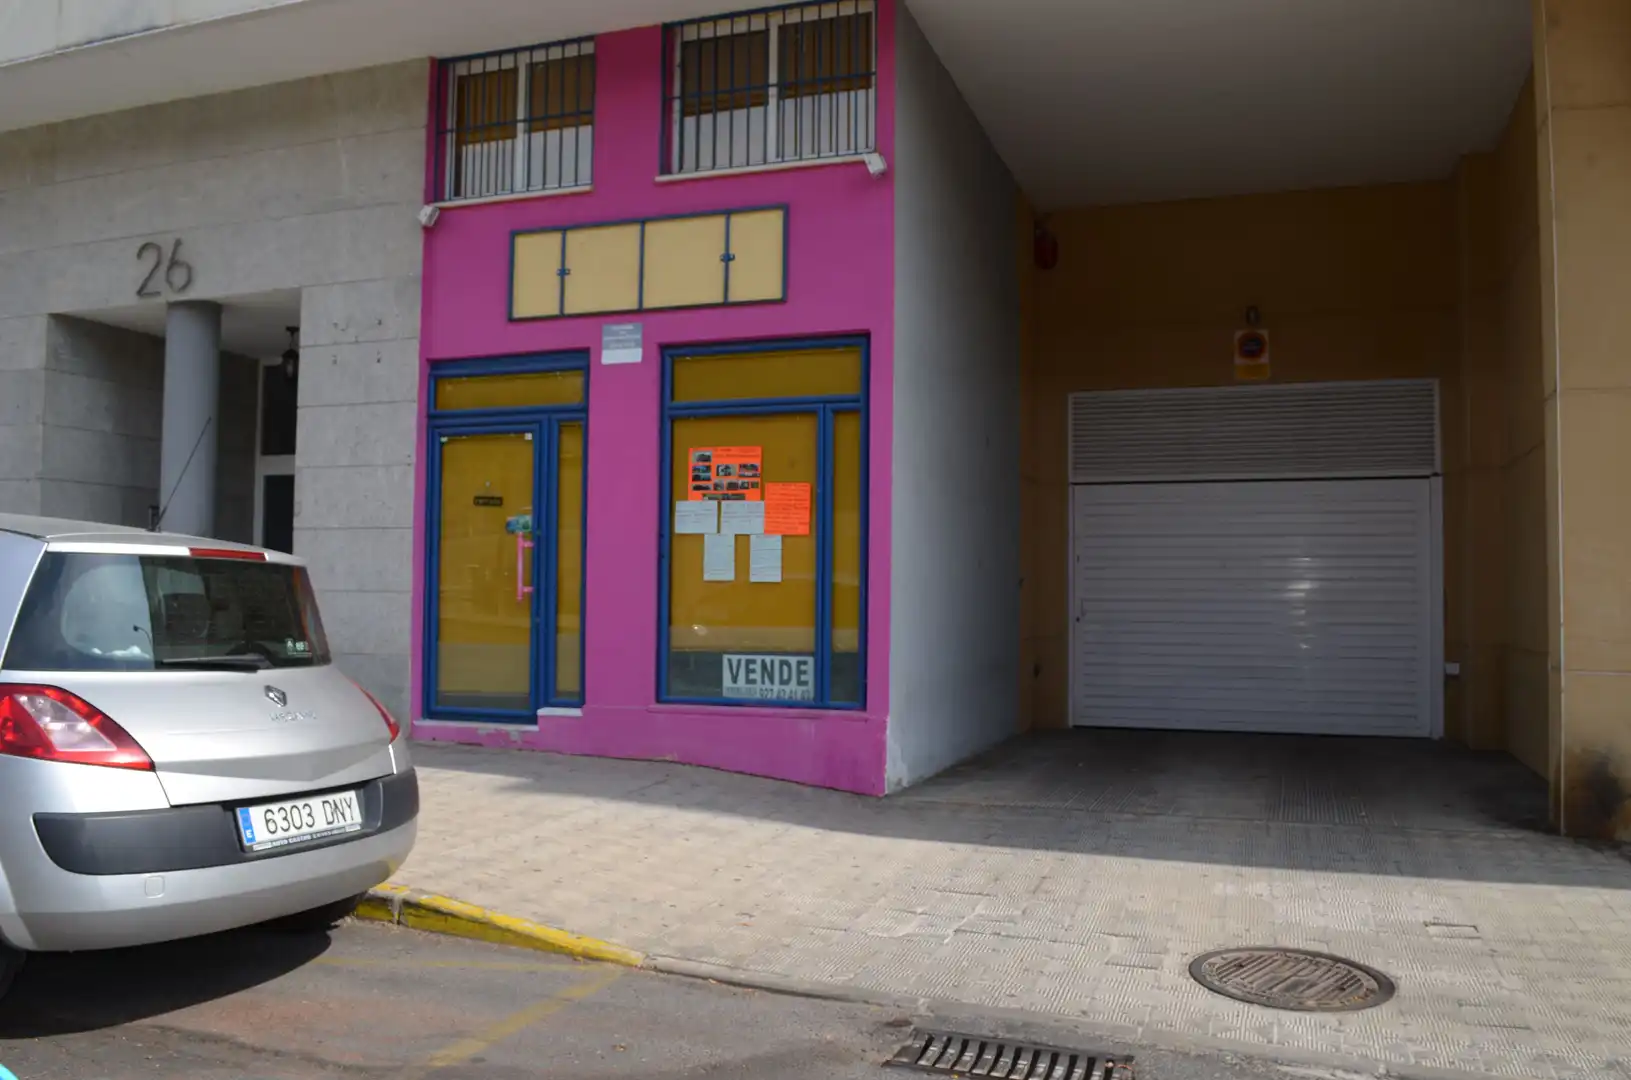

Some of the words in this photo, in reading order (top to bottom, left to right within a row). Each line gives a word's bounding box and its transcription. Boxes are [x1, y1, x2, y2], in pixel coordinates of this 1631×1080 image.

[136, 238, 192, 296] 26
[727, 658, 810, 687] VENDE
[264, 803, 315, 835] 6303
[322, 797, 353, 826] DNY
[246, 829, 253, 838] E
